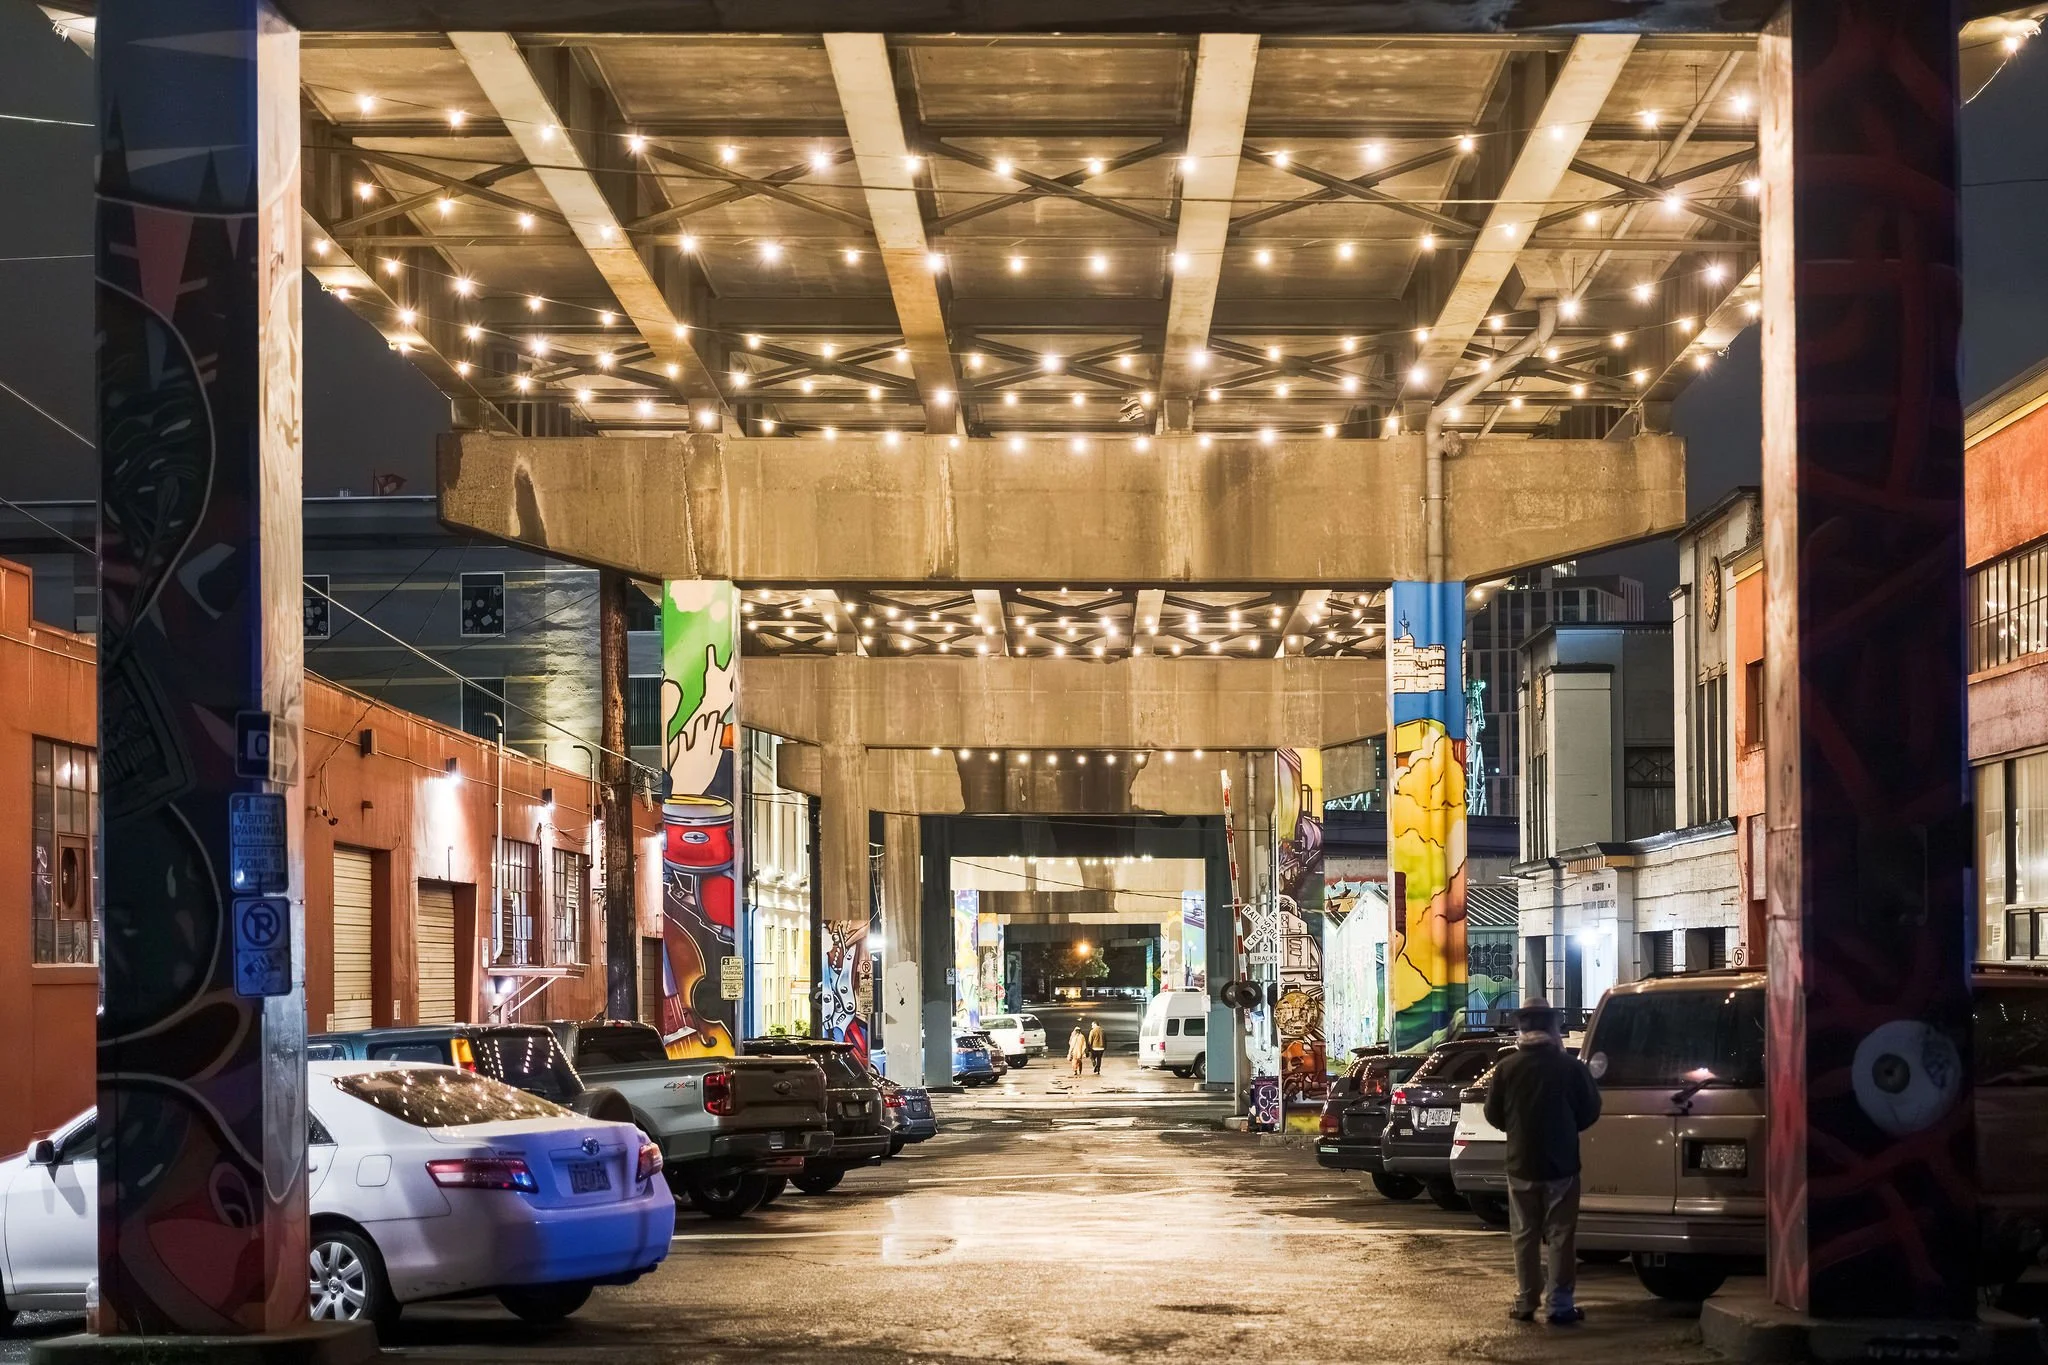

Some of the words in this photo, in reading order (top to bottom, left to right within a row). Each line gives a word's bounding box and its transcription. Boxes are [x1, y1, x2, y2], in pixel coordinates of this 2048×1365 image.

[1244, 907, 1260, 924] RAIL
[1247, 912, 1278, 946] CROSSIN
[1263, 944, 1269, 952] 2
